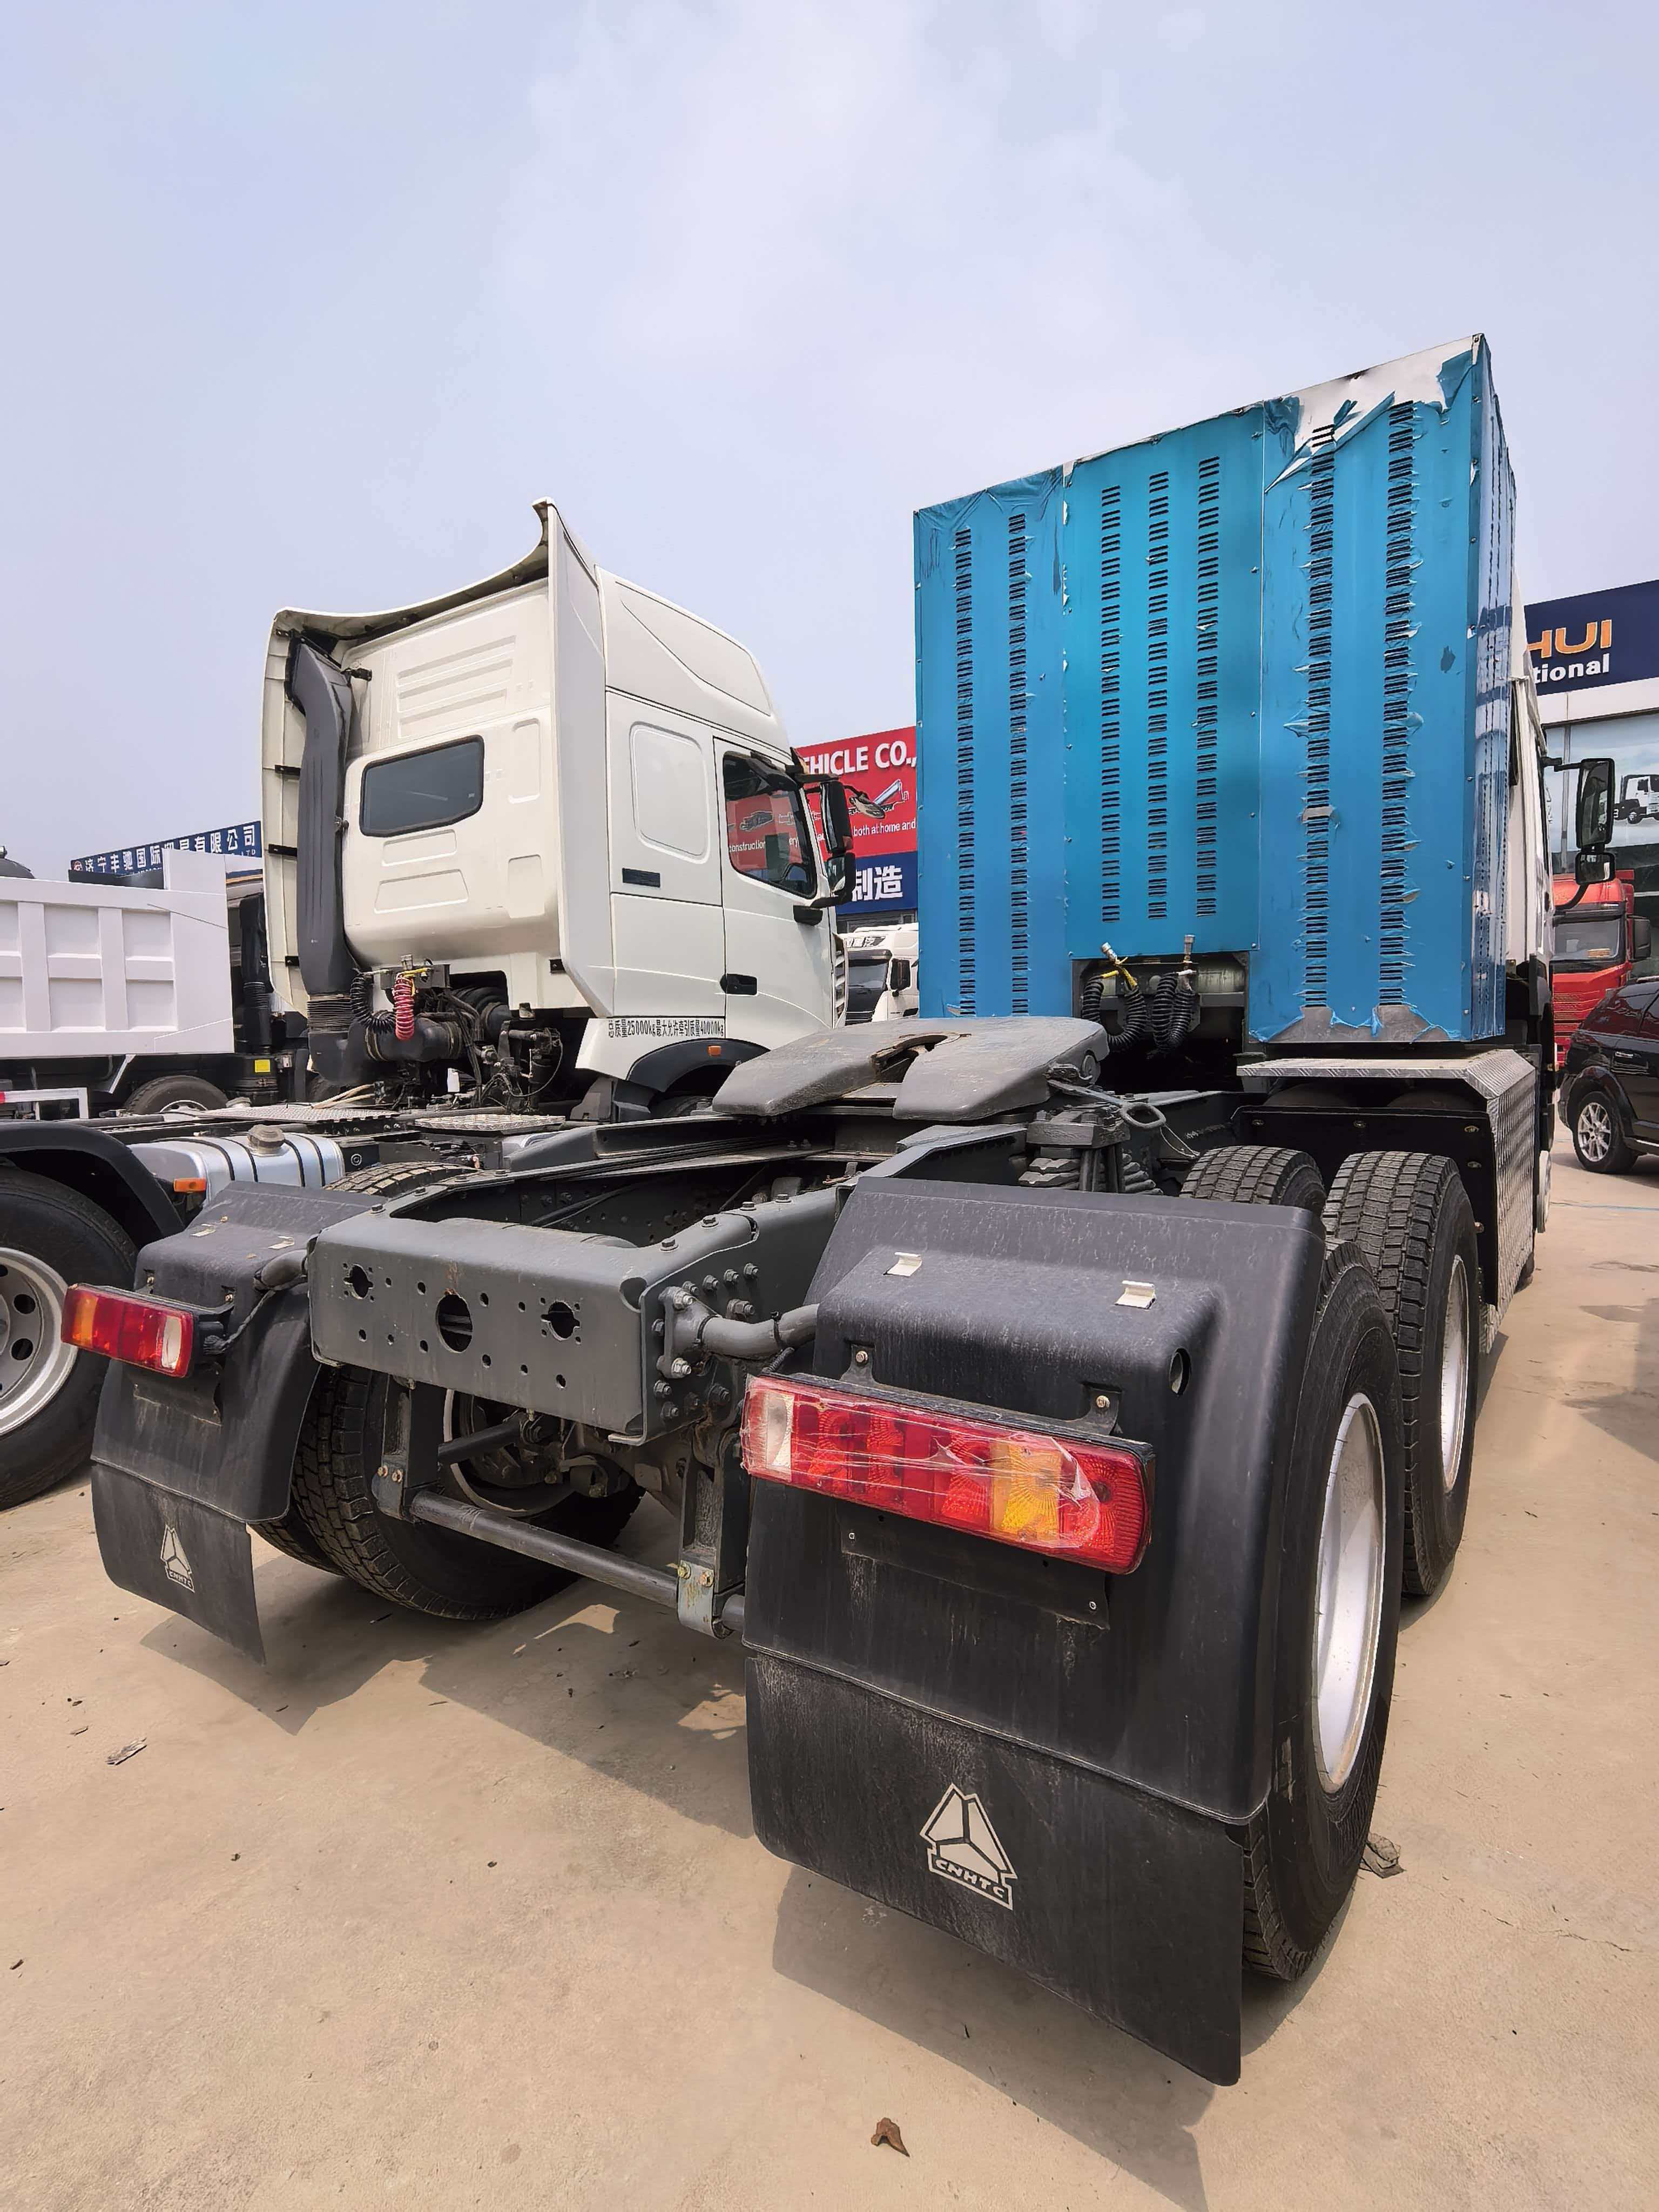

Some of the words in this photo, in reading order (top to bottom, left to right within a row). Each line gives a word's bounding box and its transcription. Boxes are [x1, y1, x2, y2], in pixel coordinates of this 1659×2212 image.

[853, 825, 870, 837] both
[871, 825, 879, 834] at
[880, 822, 900, 833] home
[901, 818, 916, 830] and
[852, 865, 903, 902] 制造
[935, 1858, 1005, 1898] CNHTC
